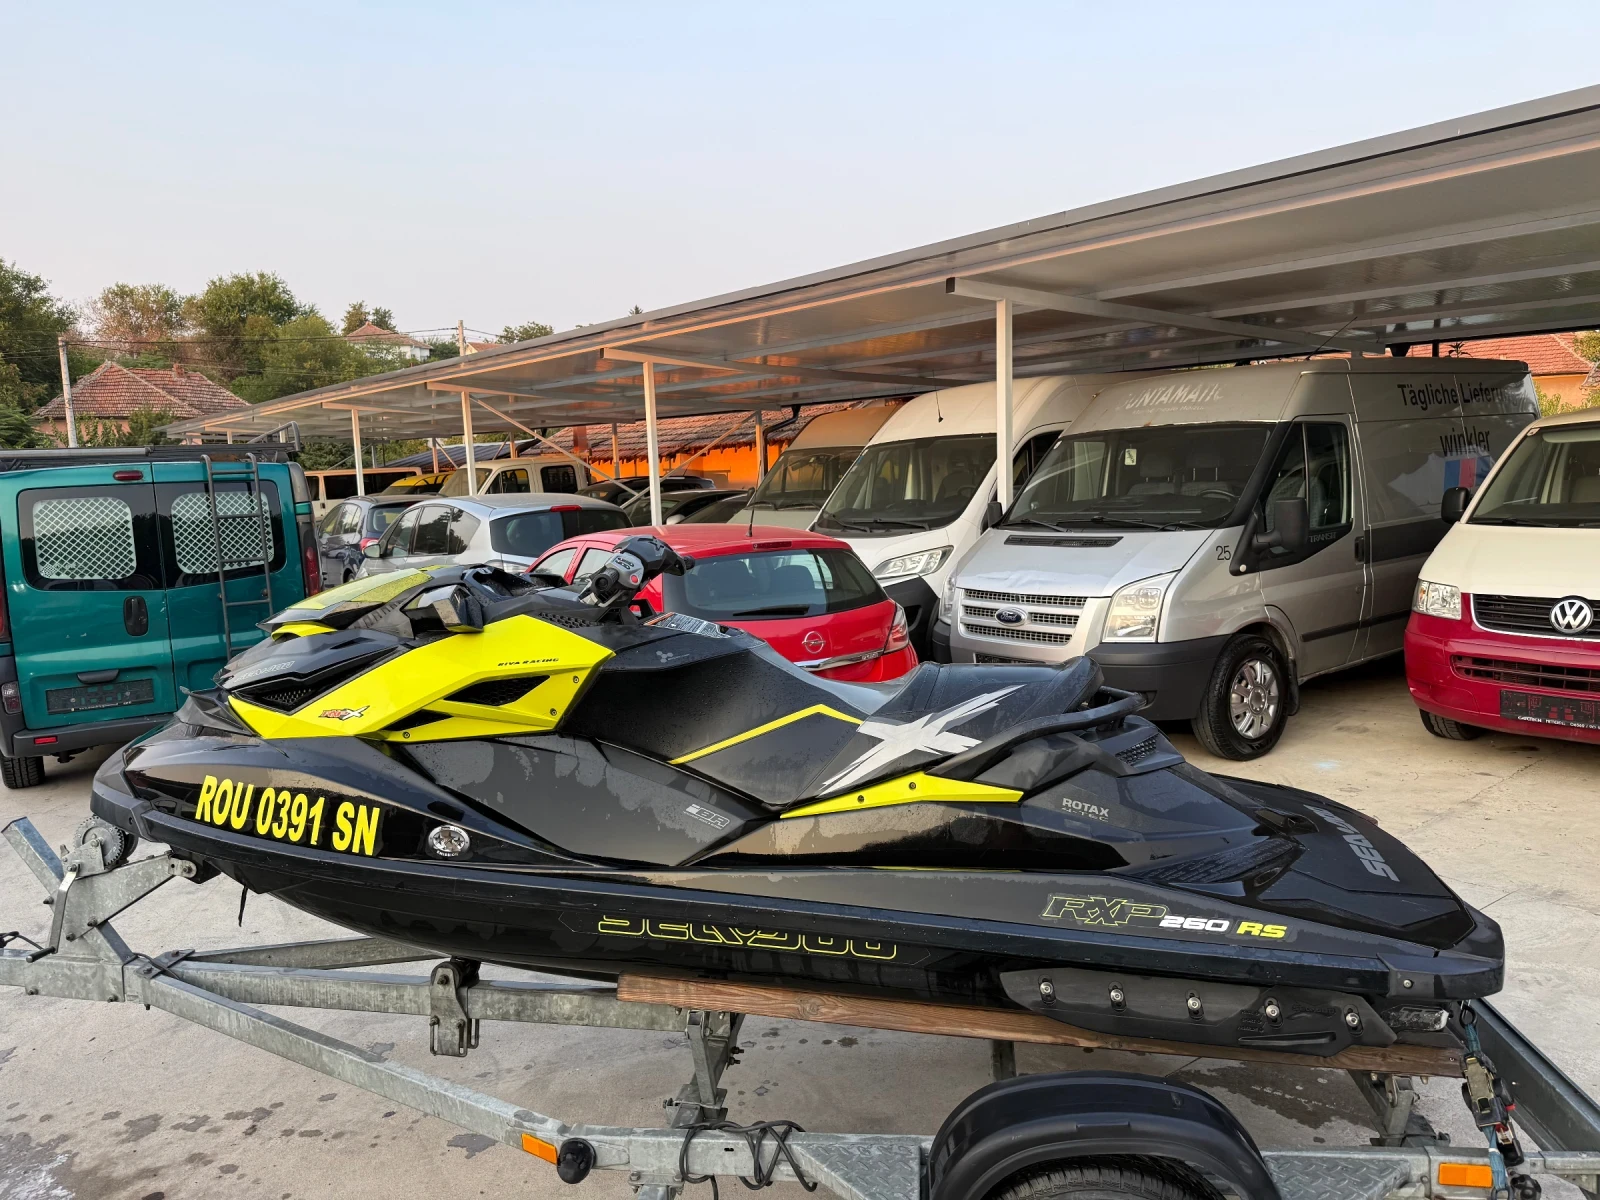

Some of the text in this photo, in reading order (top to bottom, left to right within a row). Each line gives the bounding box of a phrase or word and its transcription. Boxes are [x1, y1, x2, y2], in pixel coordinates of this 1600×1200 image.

[1397, 383, 1459, 411] Tägliche
[1440, 426, 1490, 457] winkler
[1216, 545, 1231, 560] 25
[1000, 611, 1017, 621] Ford
[195, 775, 380, 856] ROU 0391 SN
[1062, 797, 1110, 817] ROTAX
[1042, 897, 1288, 939] RXP 260 RS
